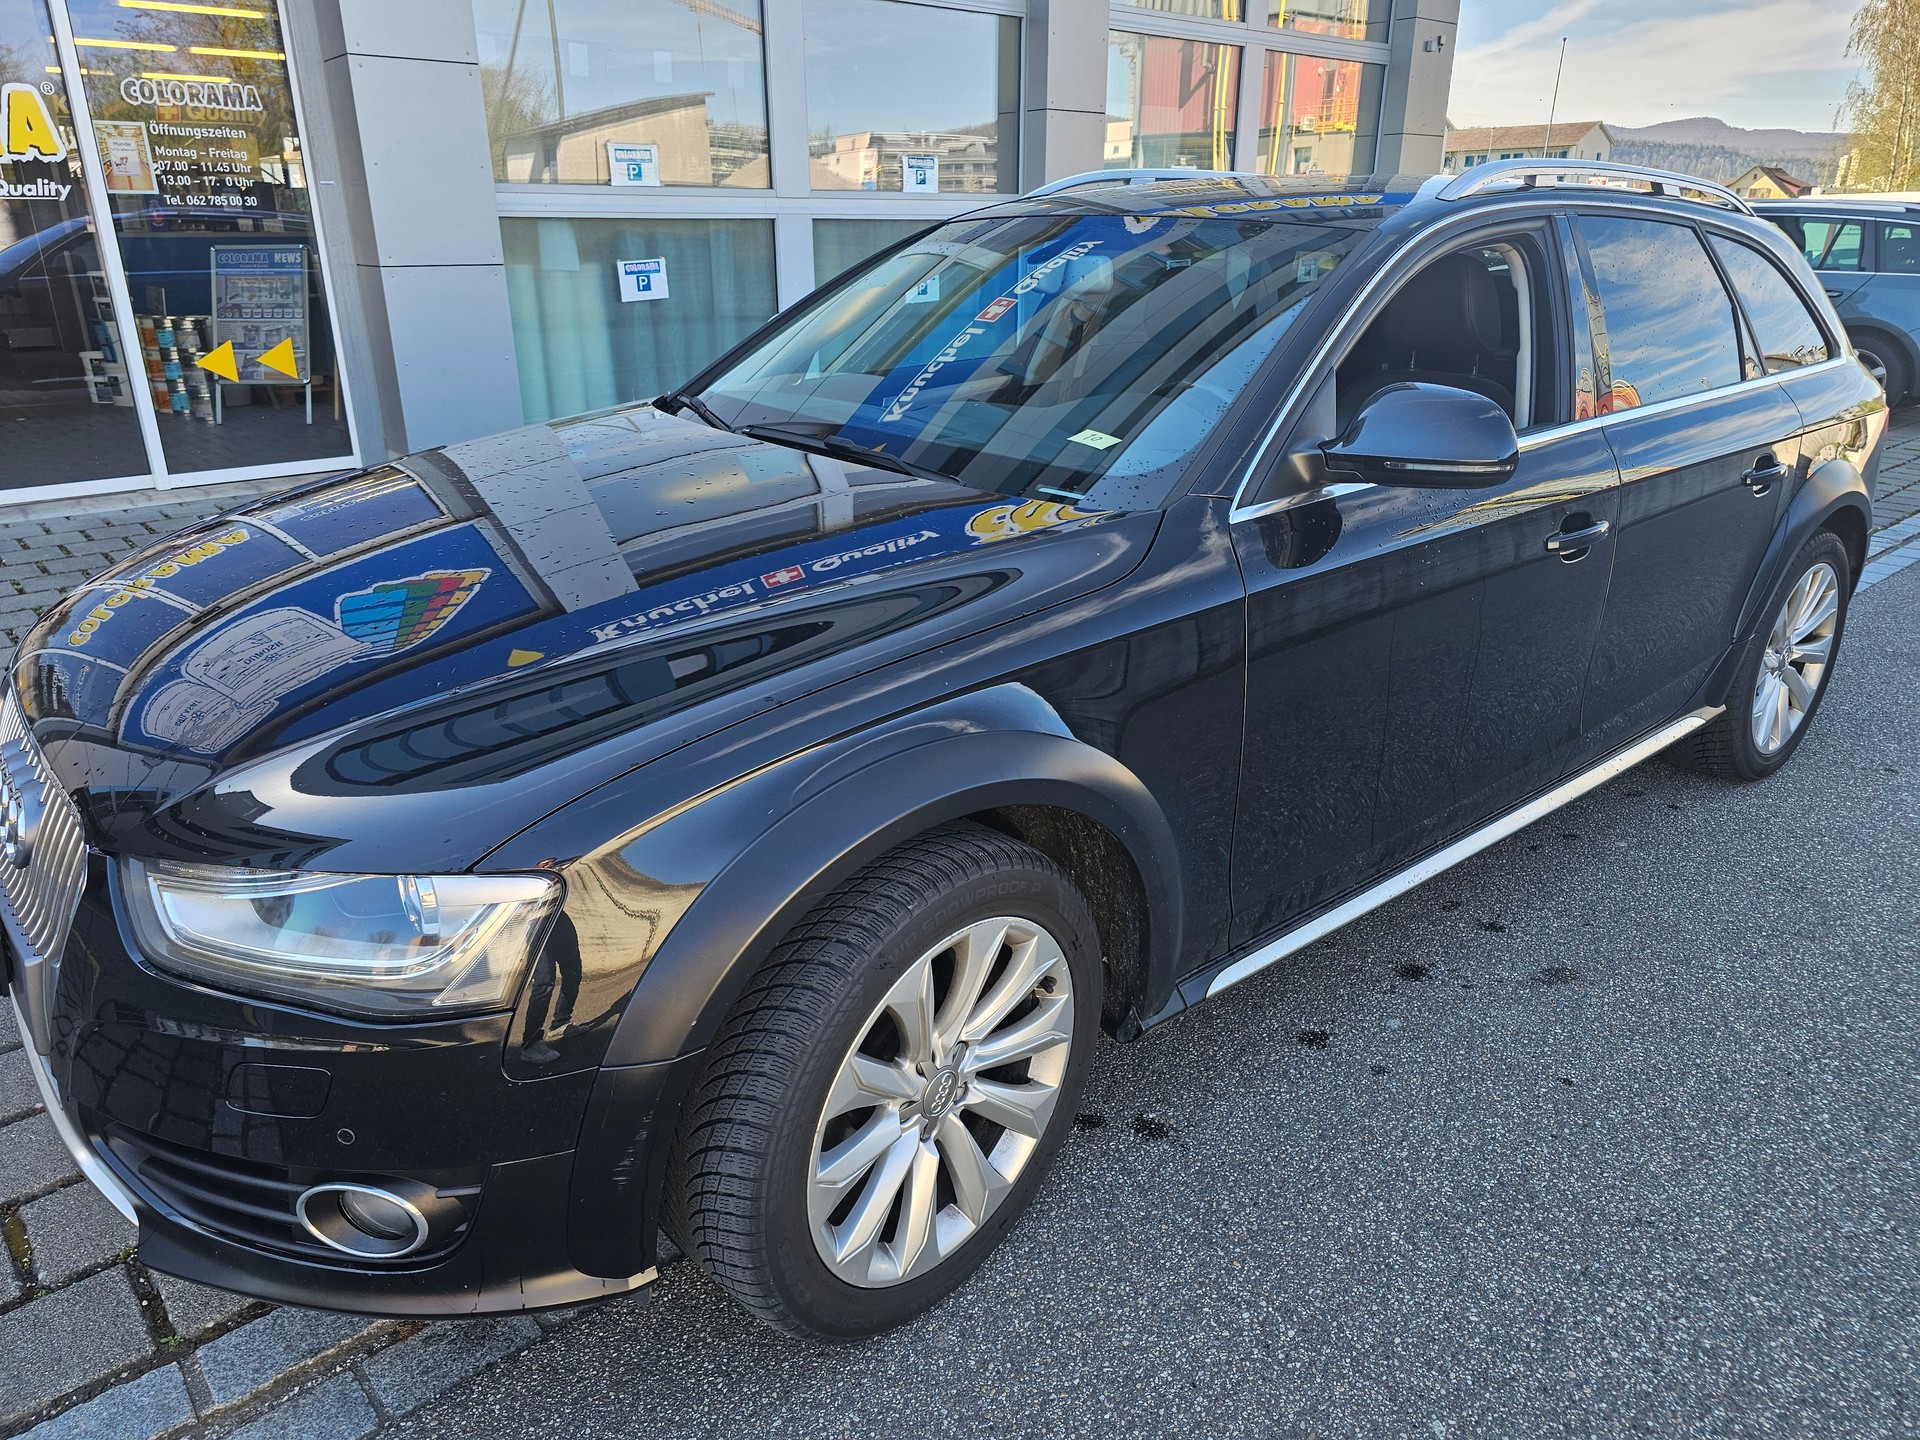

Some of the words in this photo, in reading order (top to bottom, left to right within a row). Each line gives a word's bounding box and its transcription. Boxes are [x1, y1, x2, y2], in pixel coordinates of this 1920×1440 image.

[120, 77, 263, 112] COLORAMA
[0, 82, 67, 164] A
[149, 120, 247, 139] Öffnungszeiten
[155, 145, 198, 160] Montag
[209, 147, 248, 161] Freitag
[157, 160, 189, 172] 07.00
[200, 161, 230, 173] 11.45
[232, 162, 253, 174] Uhr
[629, 164, 639, 180] P
[160, 174, 191, 186] 13.00
[234, 176, 255, 187] Uhr
[163, 194, 185, 206] Tel.
[187, 195, 207, 206] 062
[209, 195, 228, 206] 785
[229, 195, 243, 207] 00
[245, 196, 258, 207] 30
[217, 252, 269, 264] COLORAMA
[274, 252, 302, 264] NEWS
[638, 276, 648, 290] P
